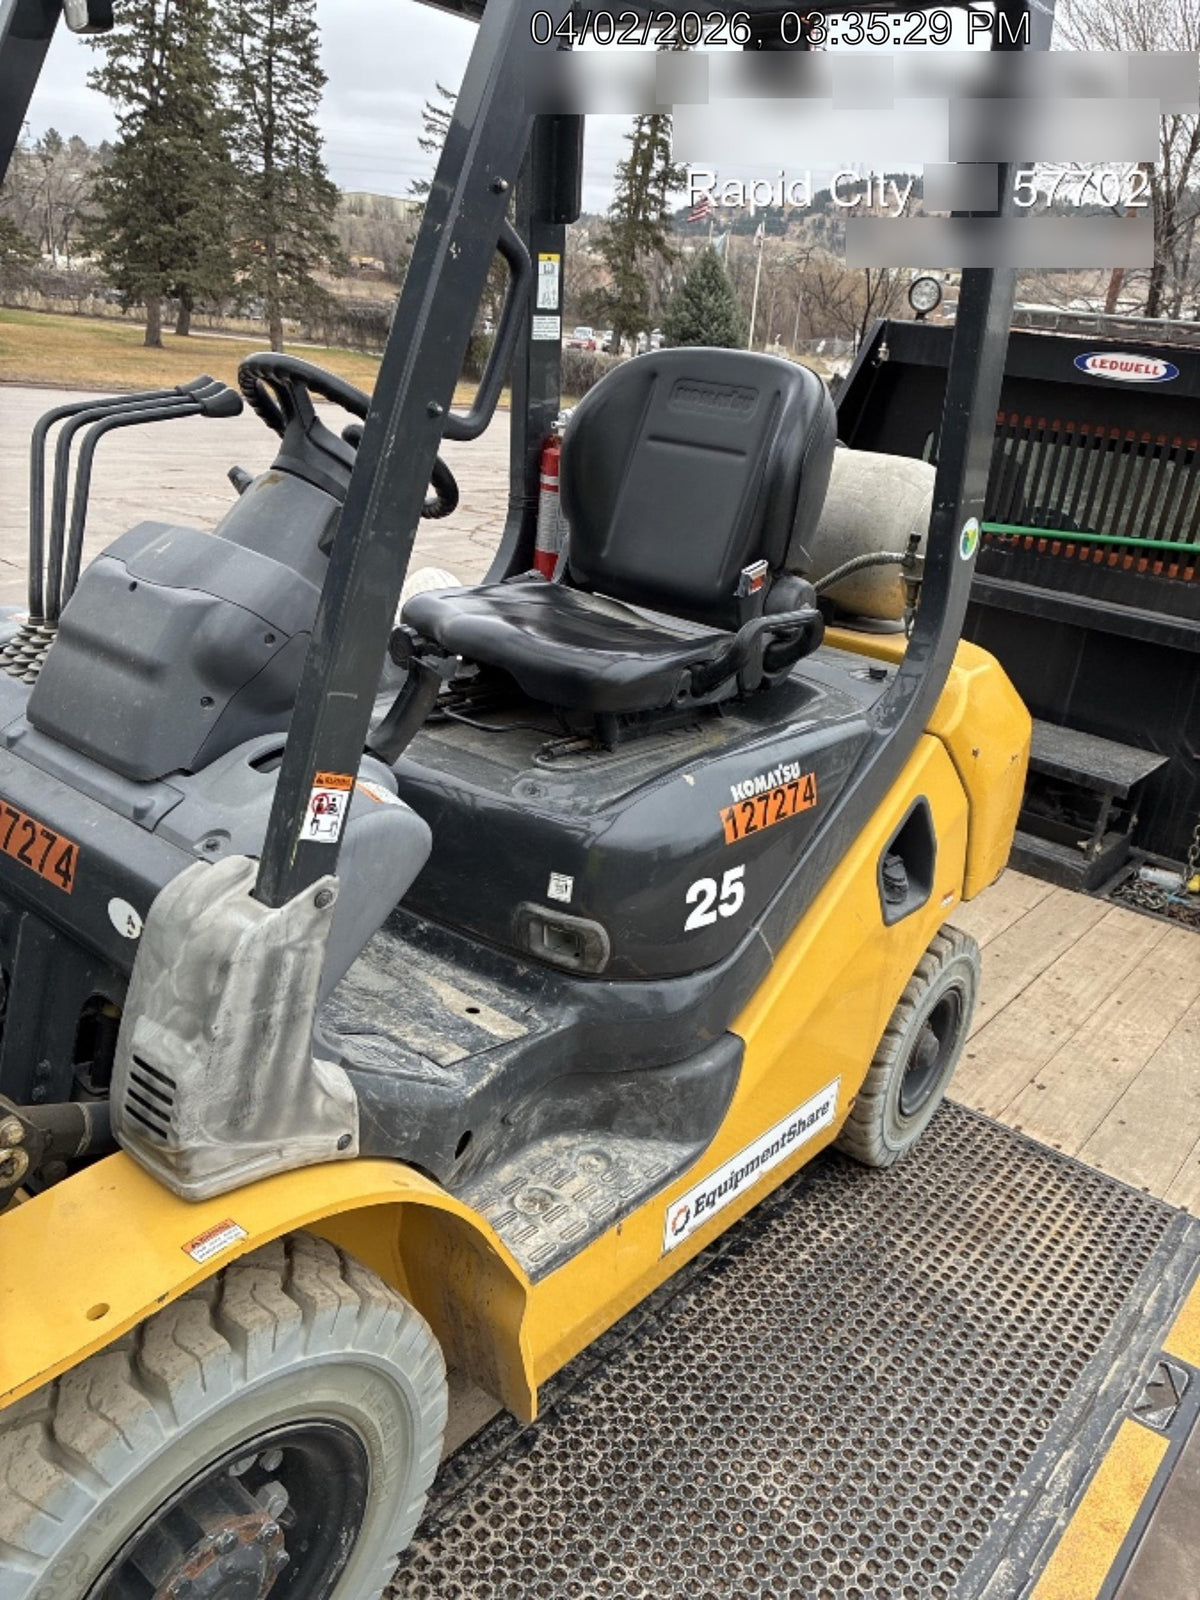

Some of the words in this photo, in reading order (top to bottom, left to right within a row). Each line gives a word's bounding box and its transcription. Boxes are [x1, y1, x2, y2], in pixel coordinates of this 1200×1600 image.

[1090, 357, 1161, 376] LEDWELL
[724, 778, 815, 840] 127274
[730, 762, 801, 802] KOMATSU
[0, 806, 74, 888] 7274
[684, 863, 746, 932] 25
[693, 1100, 830, 1218] EquipmentShare
